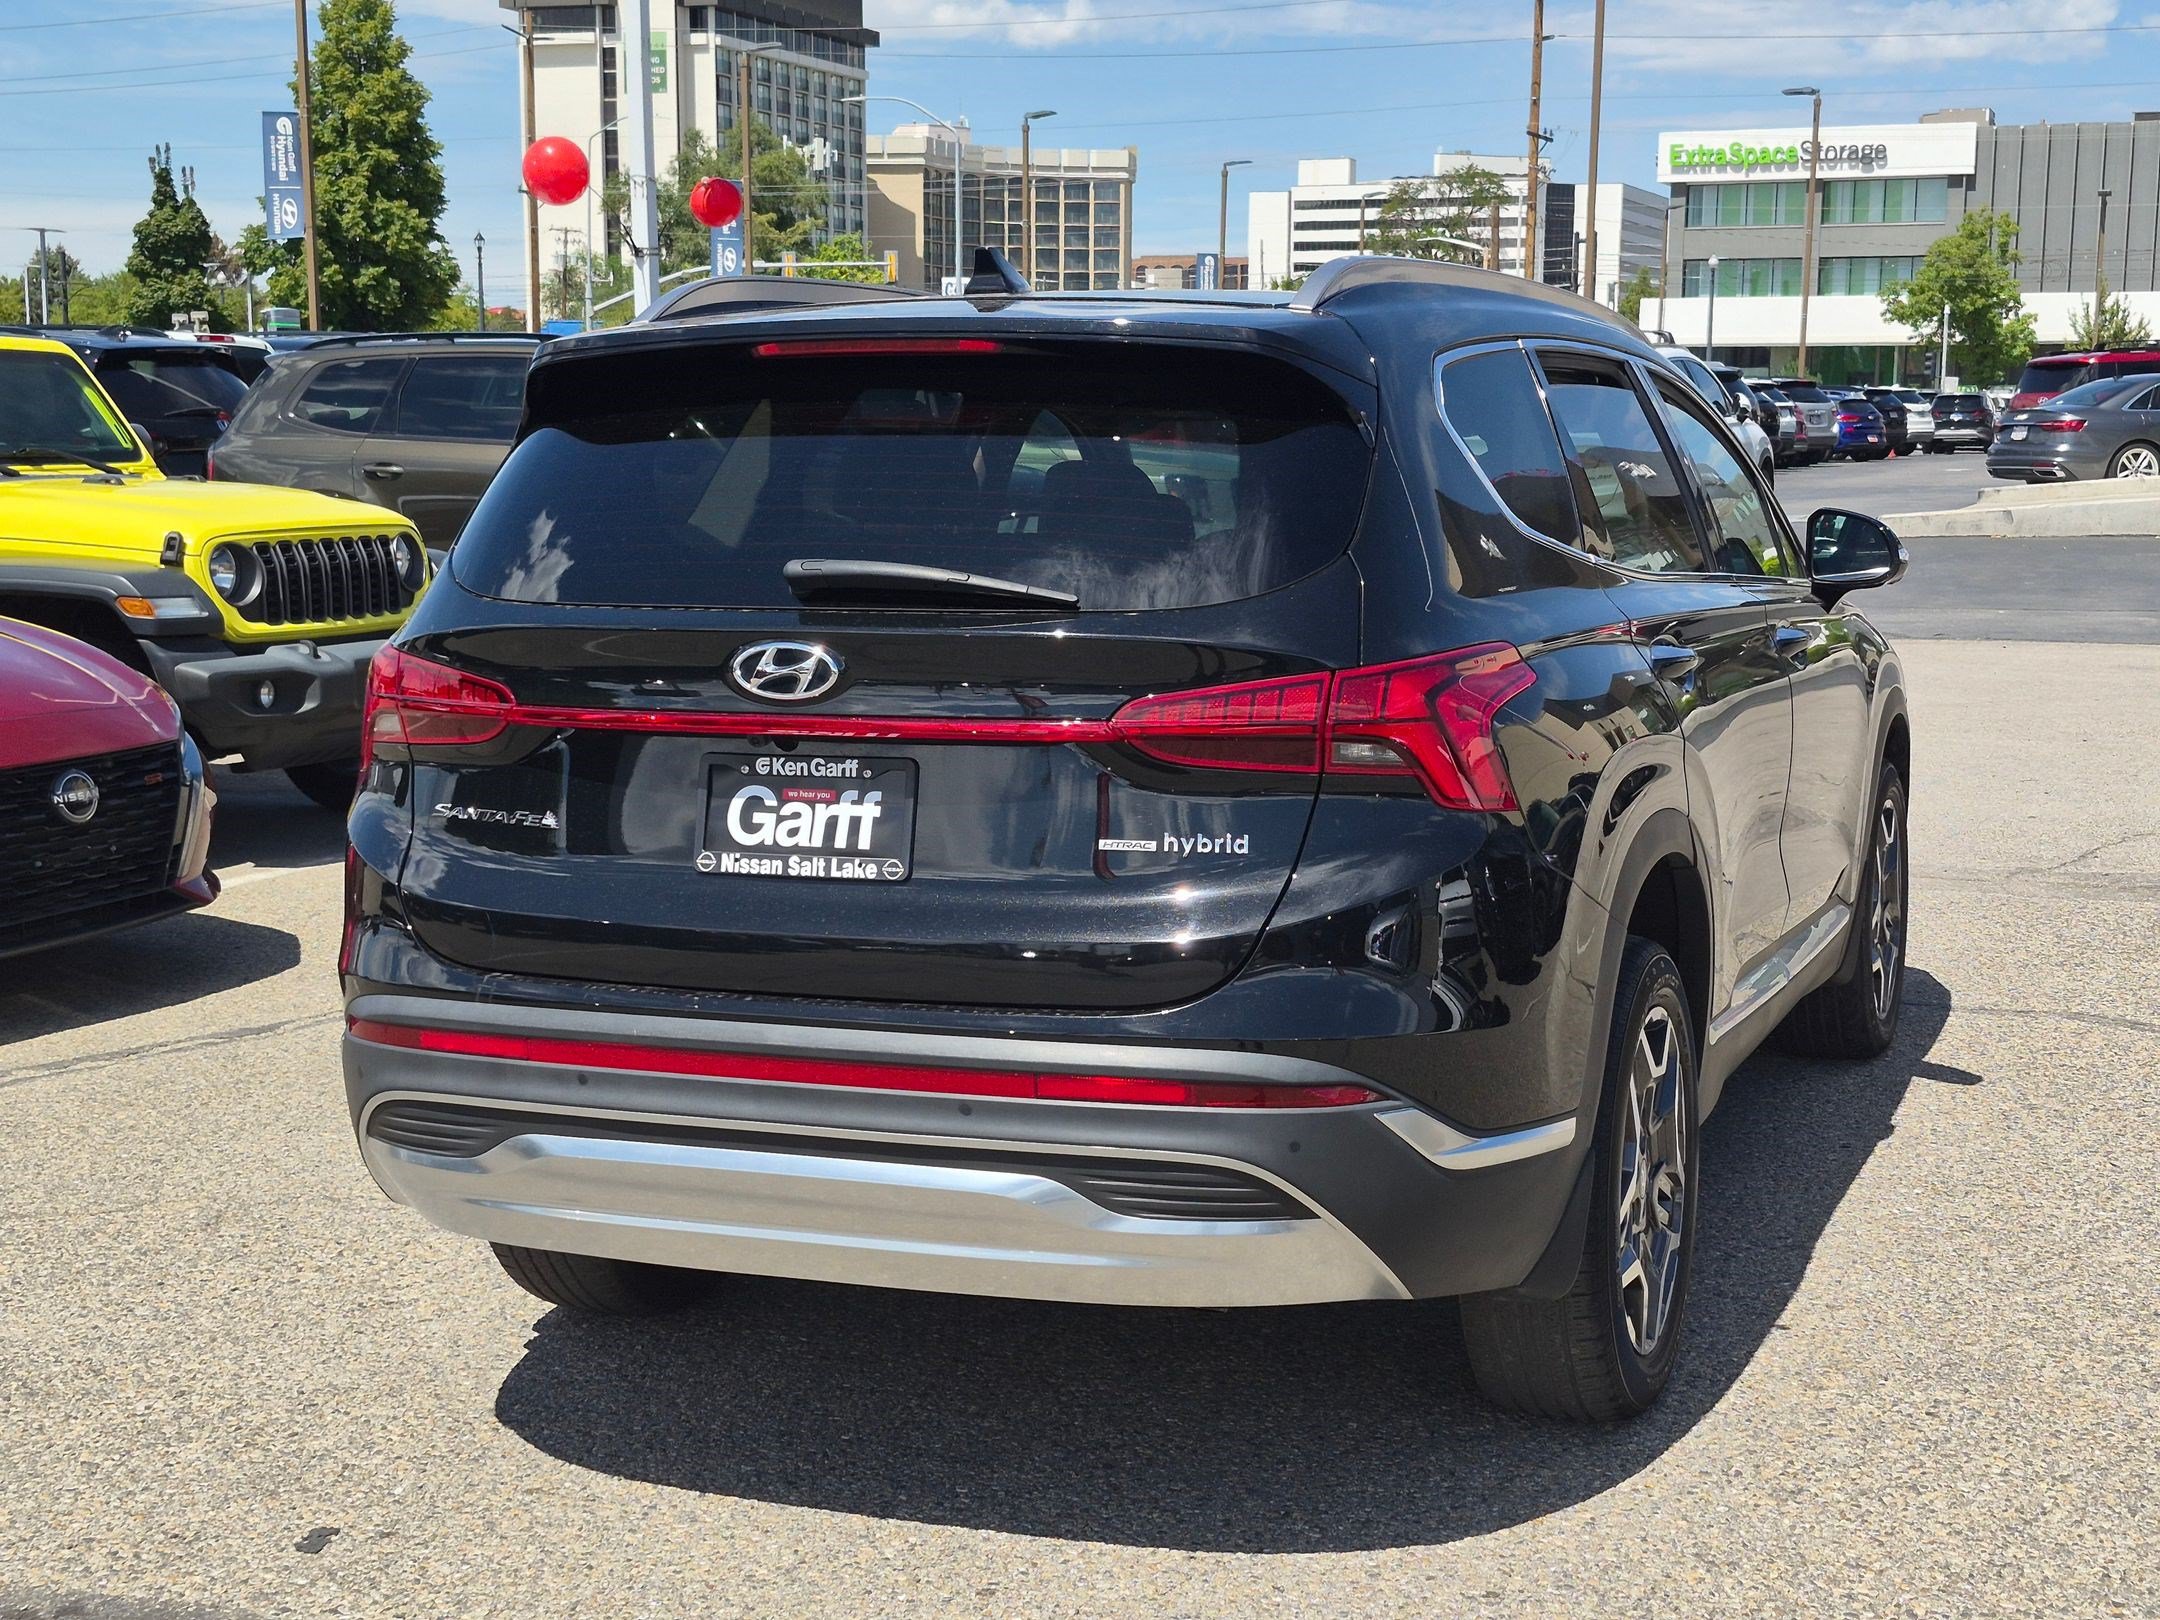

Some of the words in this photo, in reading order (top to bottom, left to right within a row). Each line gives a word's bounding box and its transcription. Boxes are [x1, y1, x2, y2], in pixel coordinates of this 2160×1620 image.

[276, 135, 289, 181] Hyundai
[273, 193, 281, 234] HYUNDAI
[772, 757, 808, 776] Ken
[810, 758, 858, 778] Garff
[54, 786, 99, 804] NISSAN
[799, 790, 815, 798] hear
[816, 791, 831, 800] you
[726, 784, 882, 850] Garff
[1102, 840, 1153, 850] HTRAC
[1163, 832, 1249, 858] hybrid
[720, 853, 783, 875] Nissan
[787, 855, 825, 877] Salt
[830, 858, 878, 879] Lake
